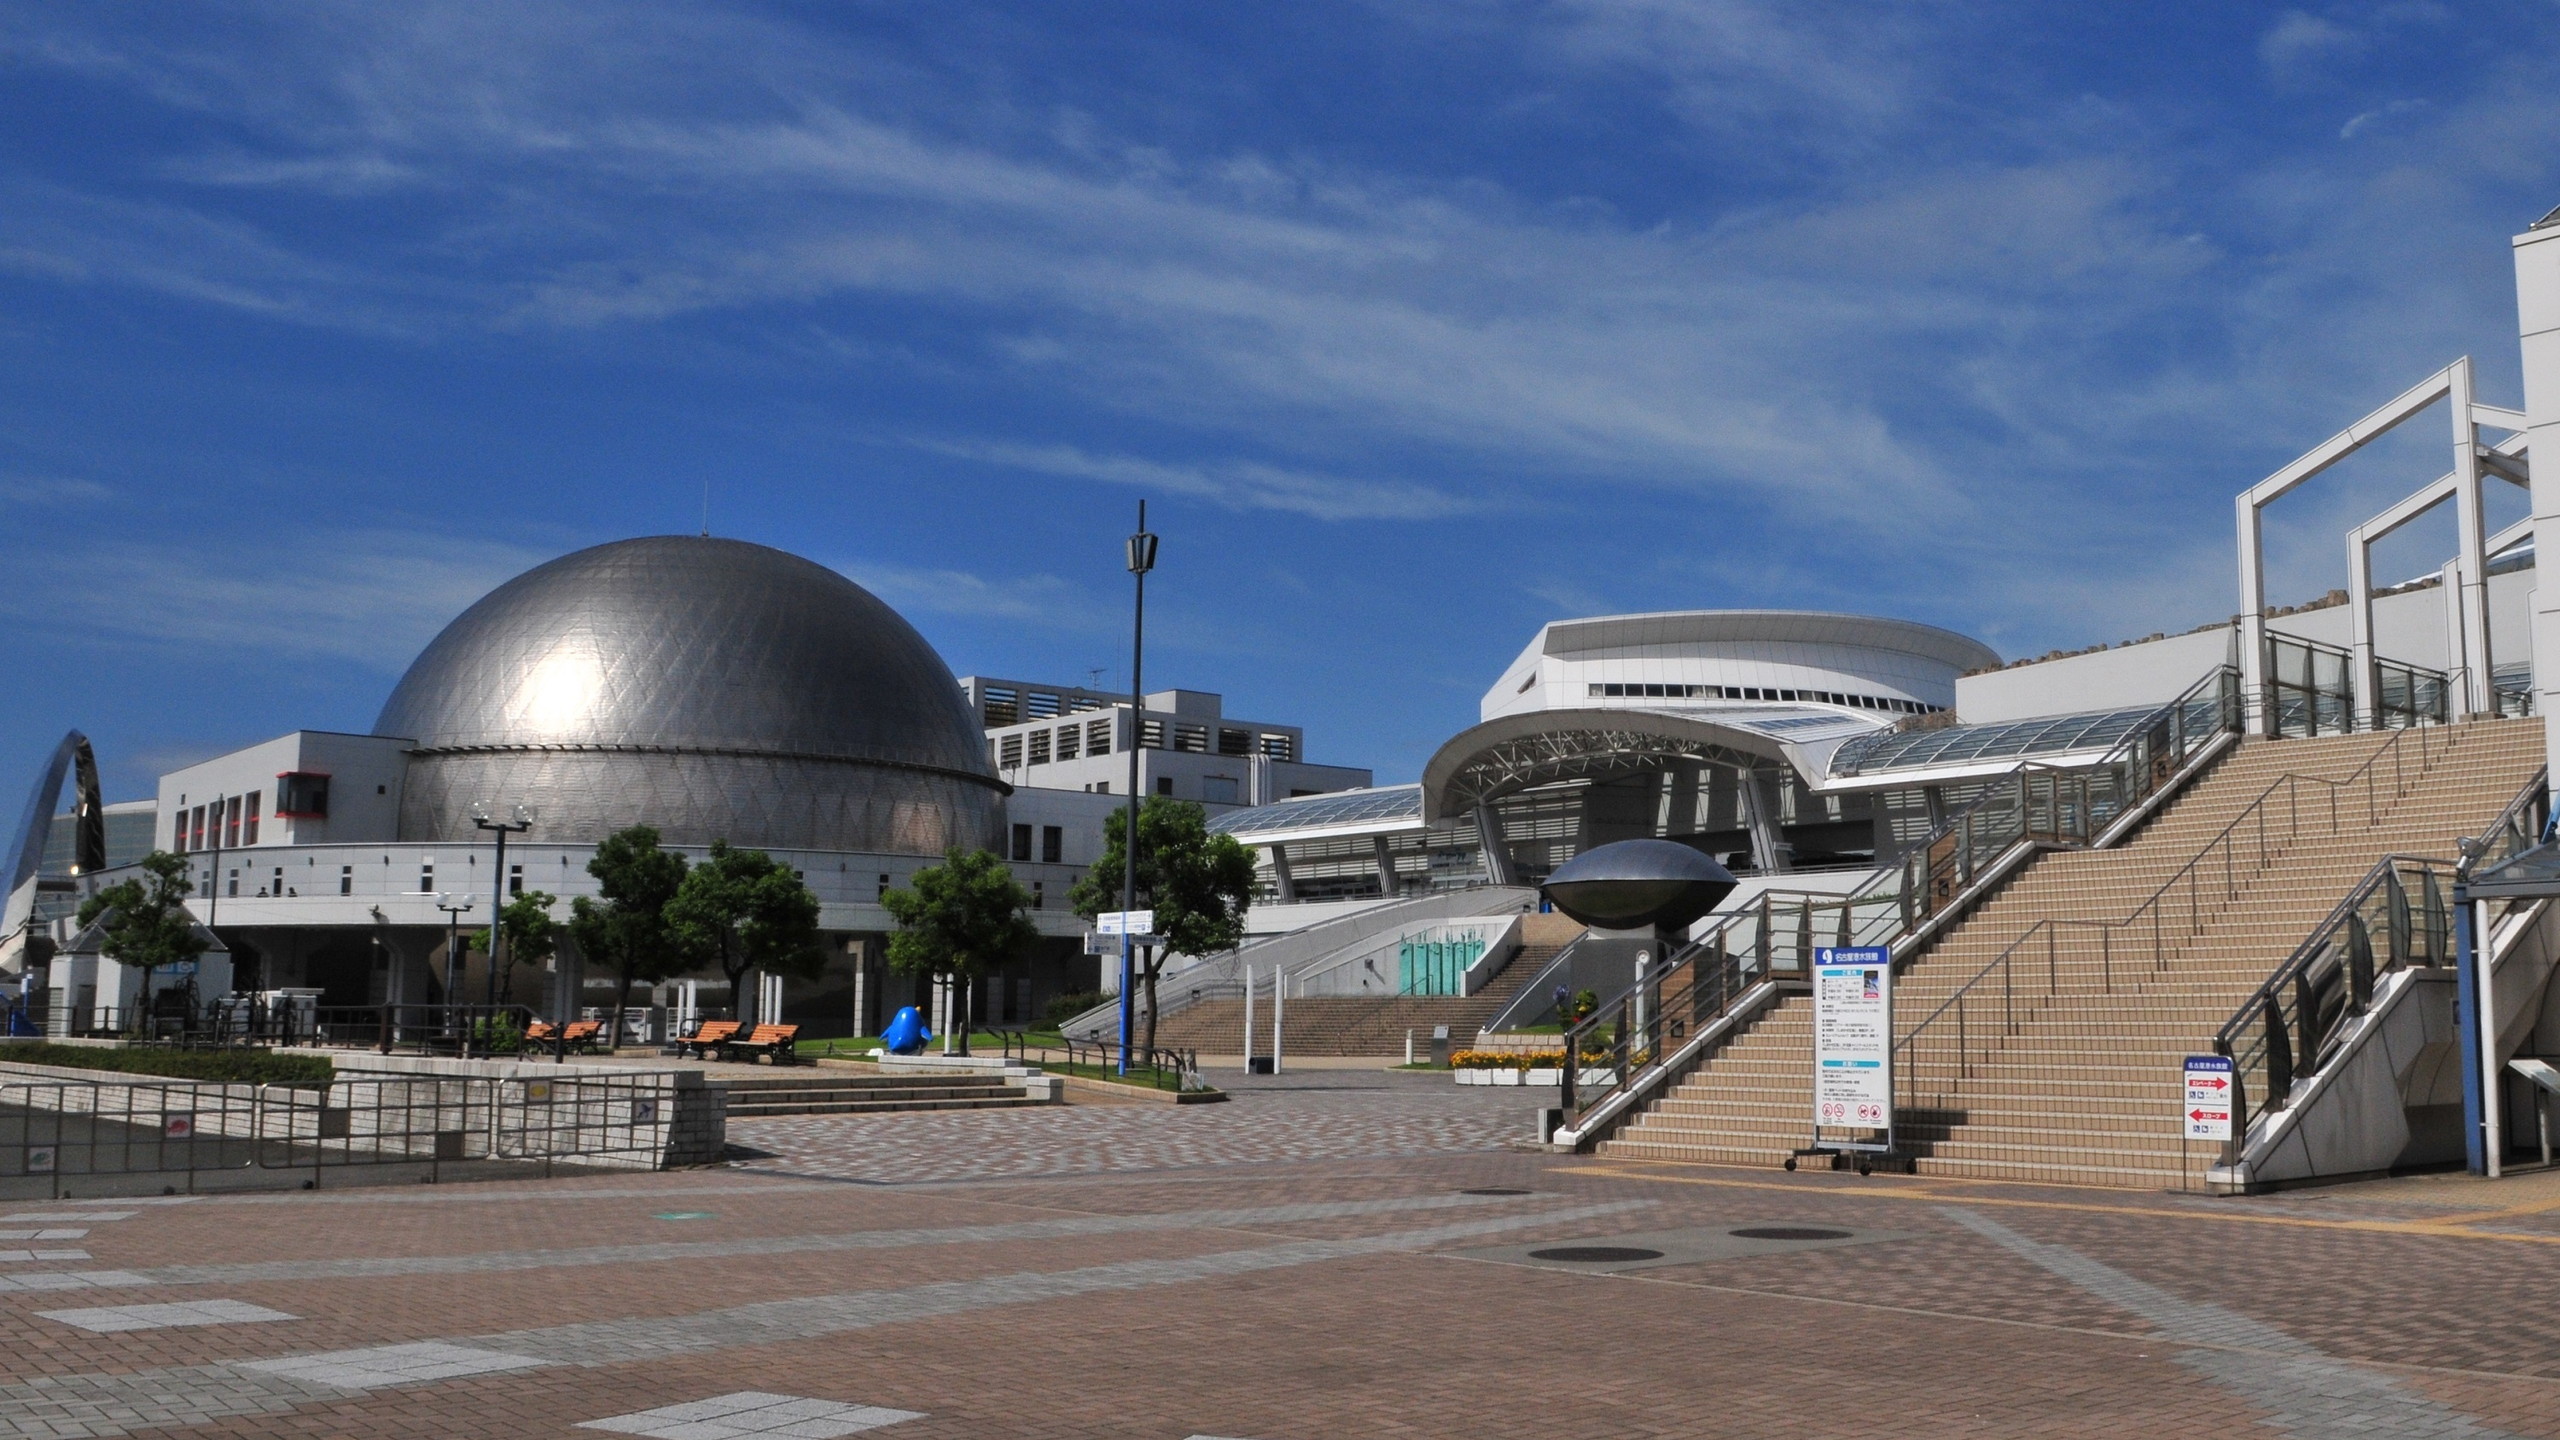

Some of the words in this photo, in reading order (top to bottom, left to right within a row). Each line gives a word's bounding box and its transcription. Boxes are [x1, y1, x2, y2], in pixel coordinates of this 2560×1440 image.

[1835, 952, 1879, 962] 名古屋港水族館
[2188, 1062, 2228, 1070] 名古屋港水族館
